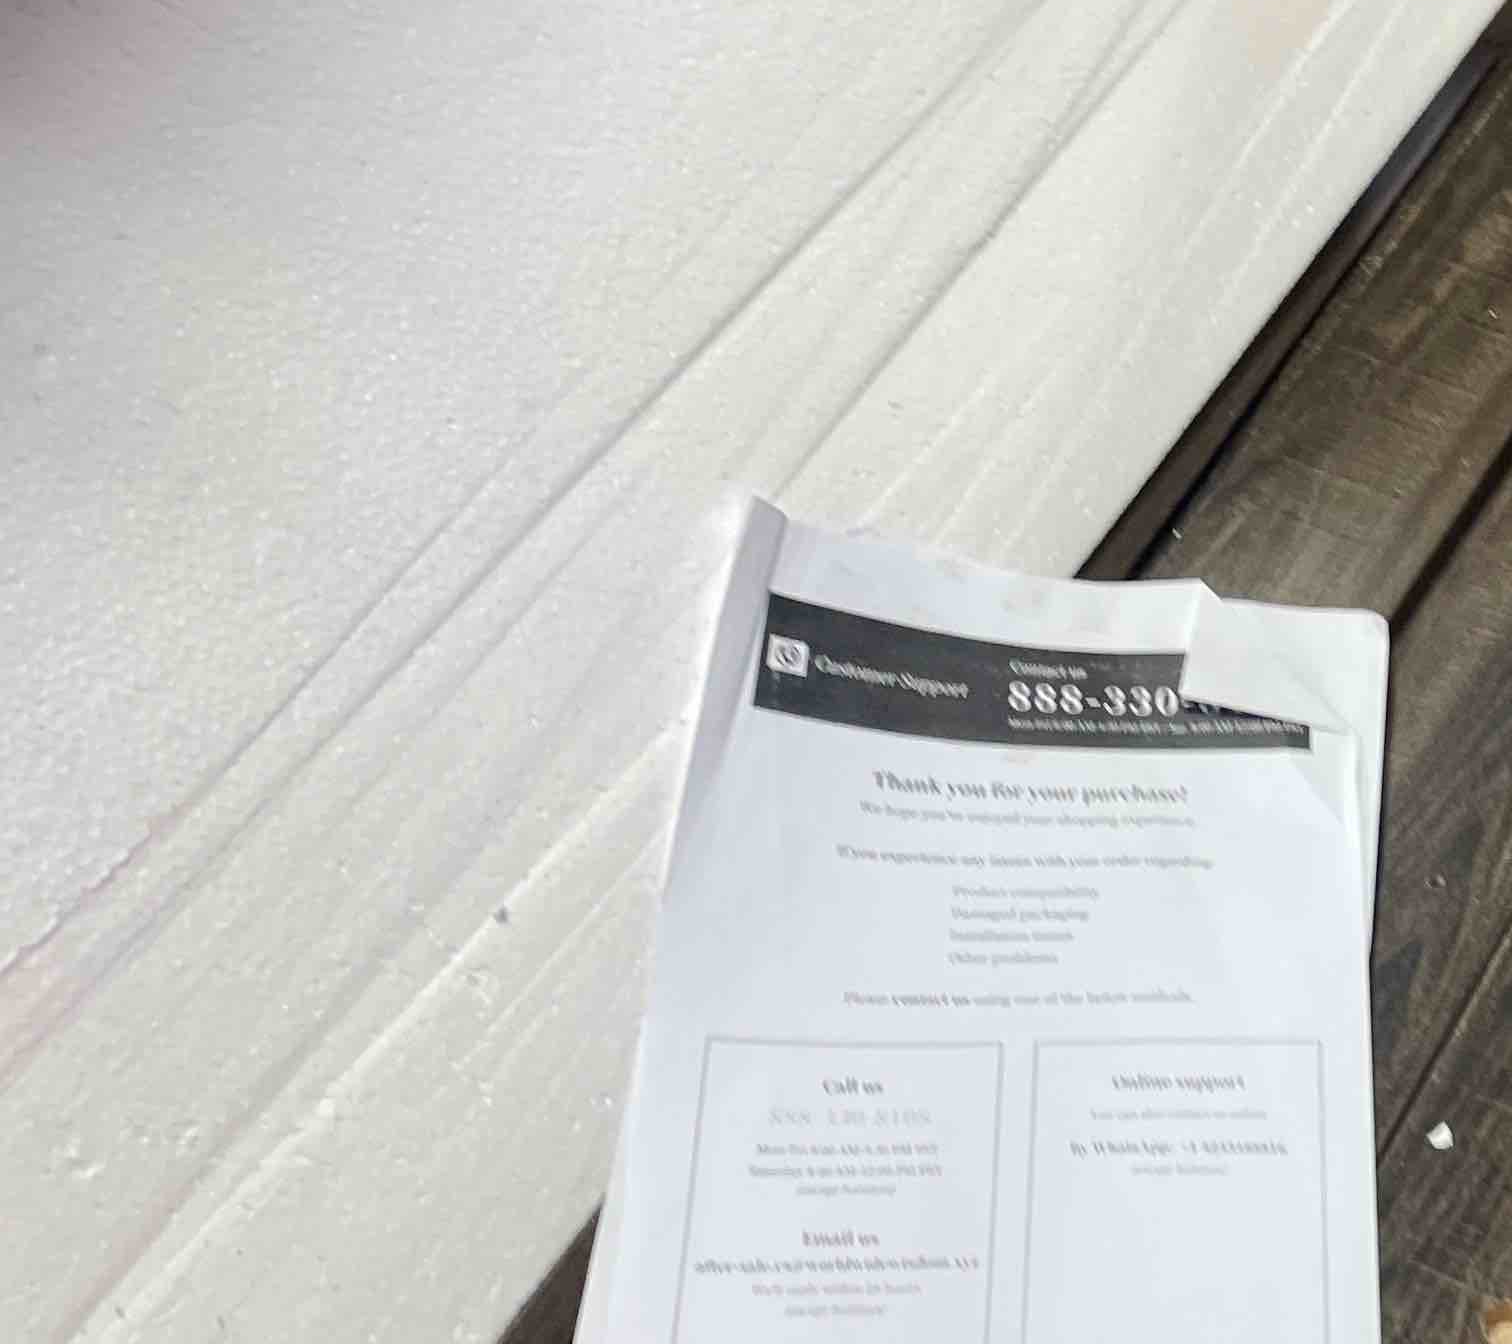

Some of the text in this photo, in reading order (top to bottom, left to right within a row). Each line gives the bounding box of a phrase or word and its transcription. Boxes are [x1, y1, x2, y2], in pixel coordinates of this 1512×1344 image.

[1008, 680, 1182, 717] 888-330
[873, 769, 941, 795] Thank
[947, 783, 986, 801] you
[990, 780, 1025, 799] for
[1028, 784, 1079, 806] your
[821, 1076, 859, 1096] Call
[801, 1229, 855, 1248] Email
